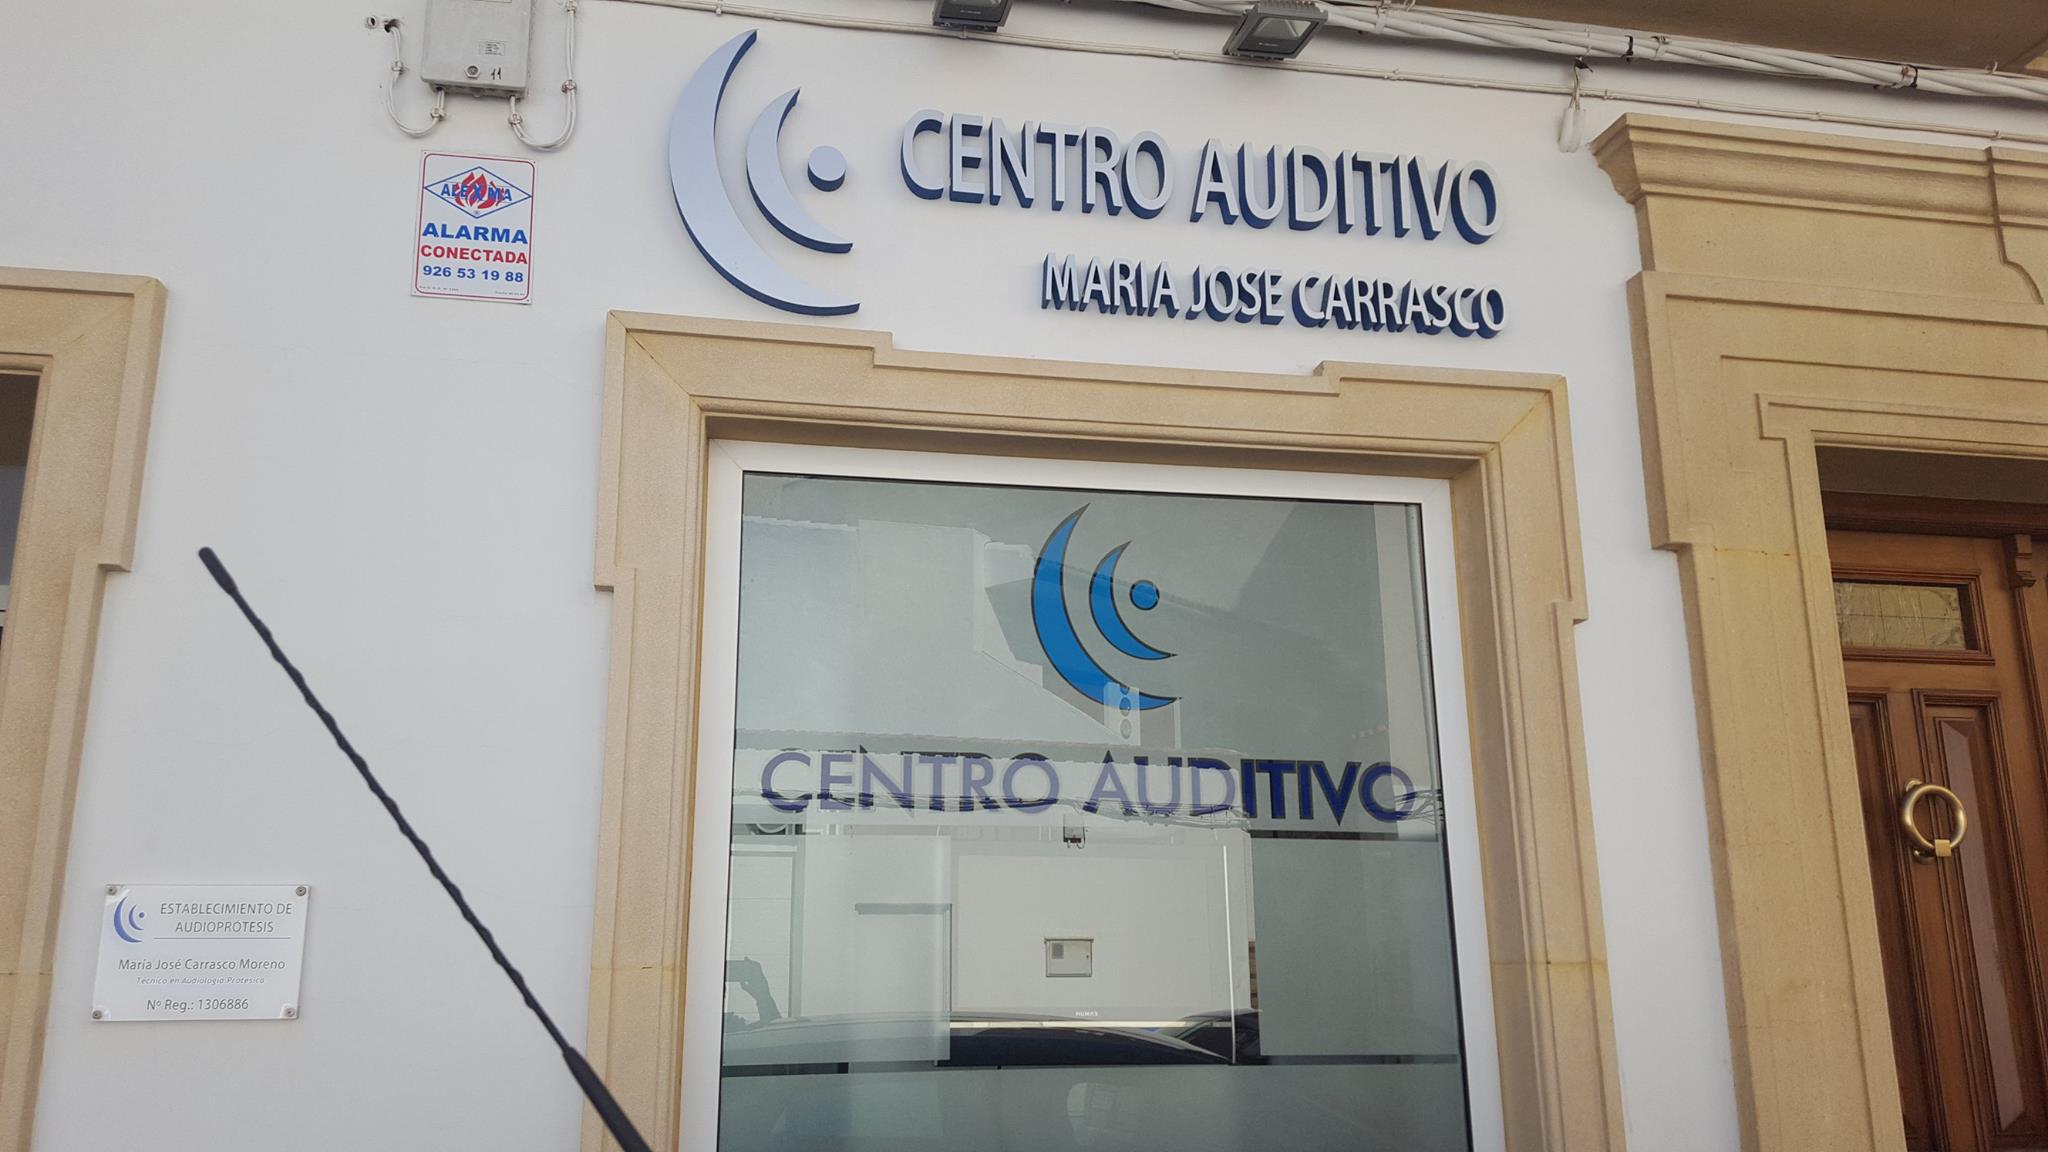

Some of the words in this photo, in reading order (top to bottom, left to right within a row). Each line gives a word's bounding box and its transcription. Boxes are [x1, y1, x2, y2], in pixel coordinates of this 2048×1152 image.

[901, 109, 1173, 220] CENTRO
[1190, 138, 1505, 244] AUDITIVO
[422, 222, 528, 244] ALARMA
[420, 244, 528, 264] CONECTADA
[423, 265, 452, 277] 926
[457, 268, 475, 279] 53
[481, 270, 499, 281] 19
[505, 272, 524, 283] 88
[1041, 252, 1180, 317] MARIA
[1185, 264, 1285, 325] JOSE
[1291, 273, 1508, 339] CARRASCO
[760, 746, 1059, 814] CENTRO
[1082, 750, 1416, 826] AUDITIVO
[160, 903, 273, 915] ESTABLECIMIENTO
[276, 903, 292, 914] DE
[184, 958, 236, 970] Carrasco
[239, 959, 286, 970] Moreno
[198, 999, 249, 1010] 1306886
